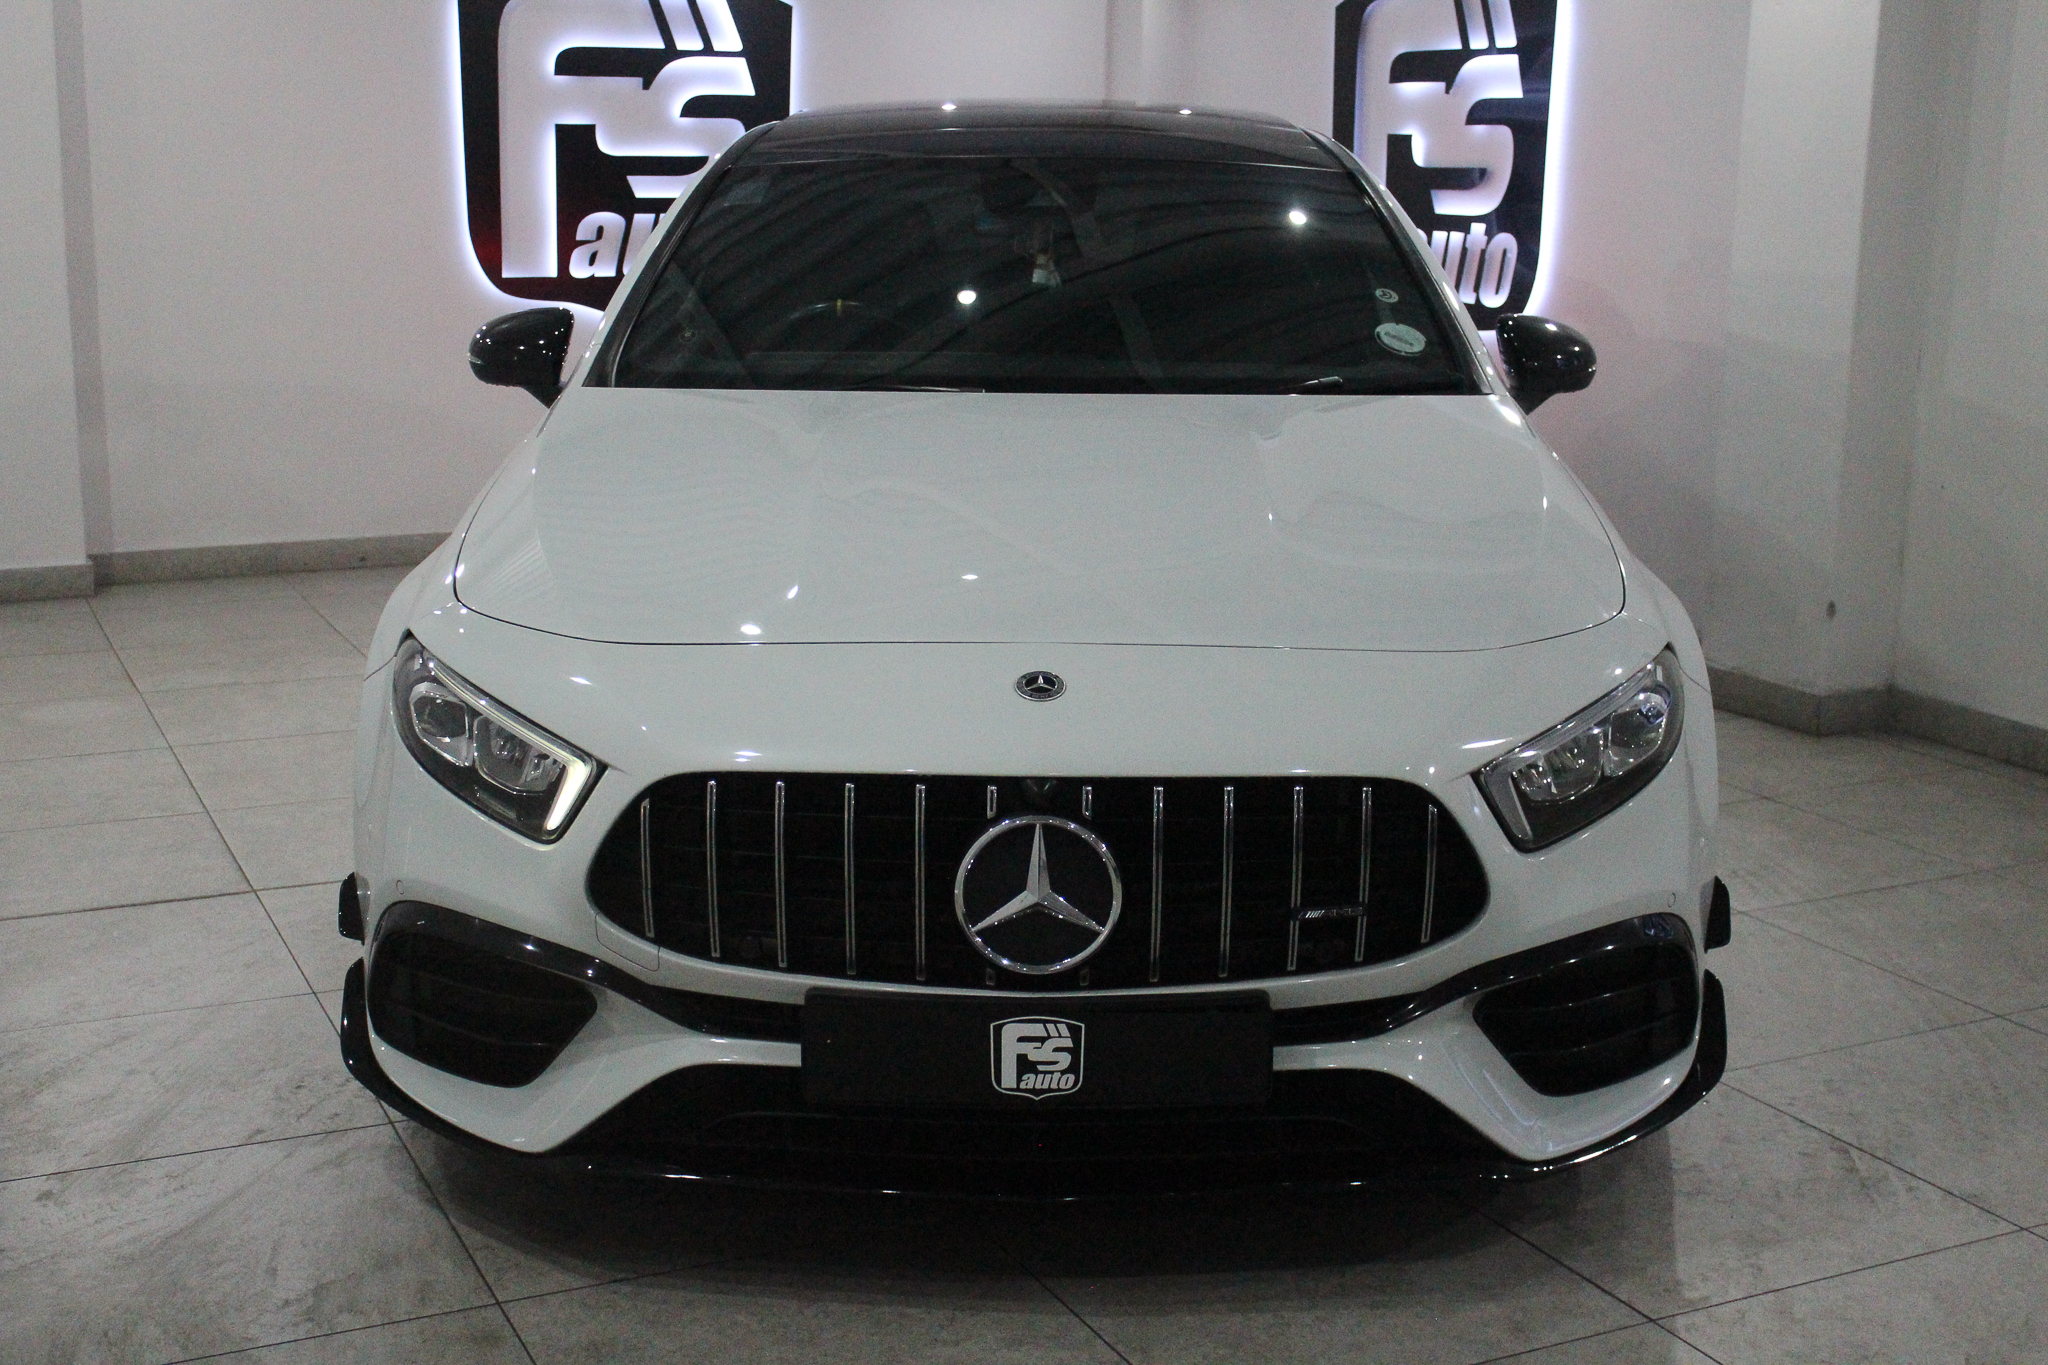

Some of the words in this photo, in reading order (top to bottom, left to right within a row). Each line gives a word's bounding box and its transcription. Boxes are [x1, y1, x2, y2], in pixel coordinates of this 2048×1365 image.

[1415, 222, 1518, 308] uto
[1001, 1023, 1074, 1089] FS
[1020, 1071, 1076, 1090] auto
